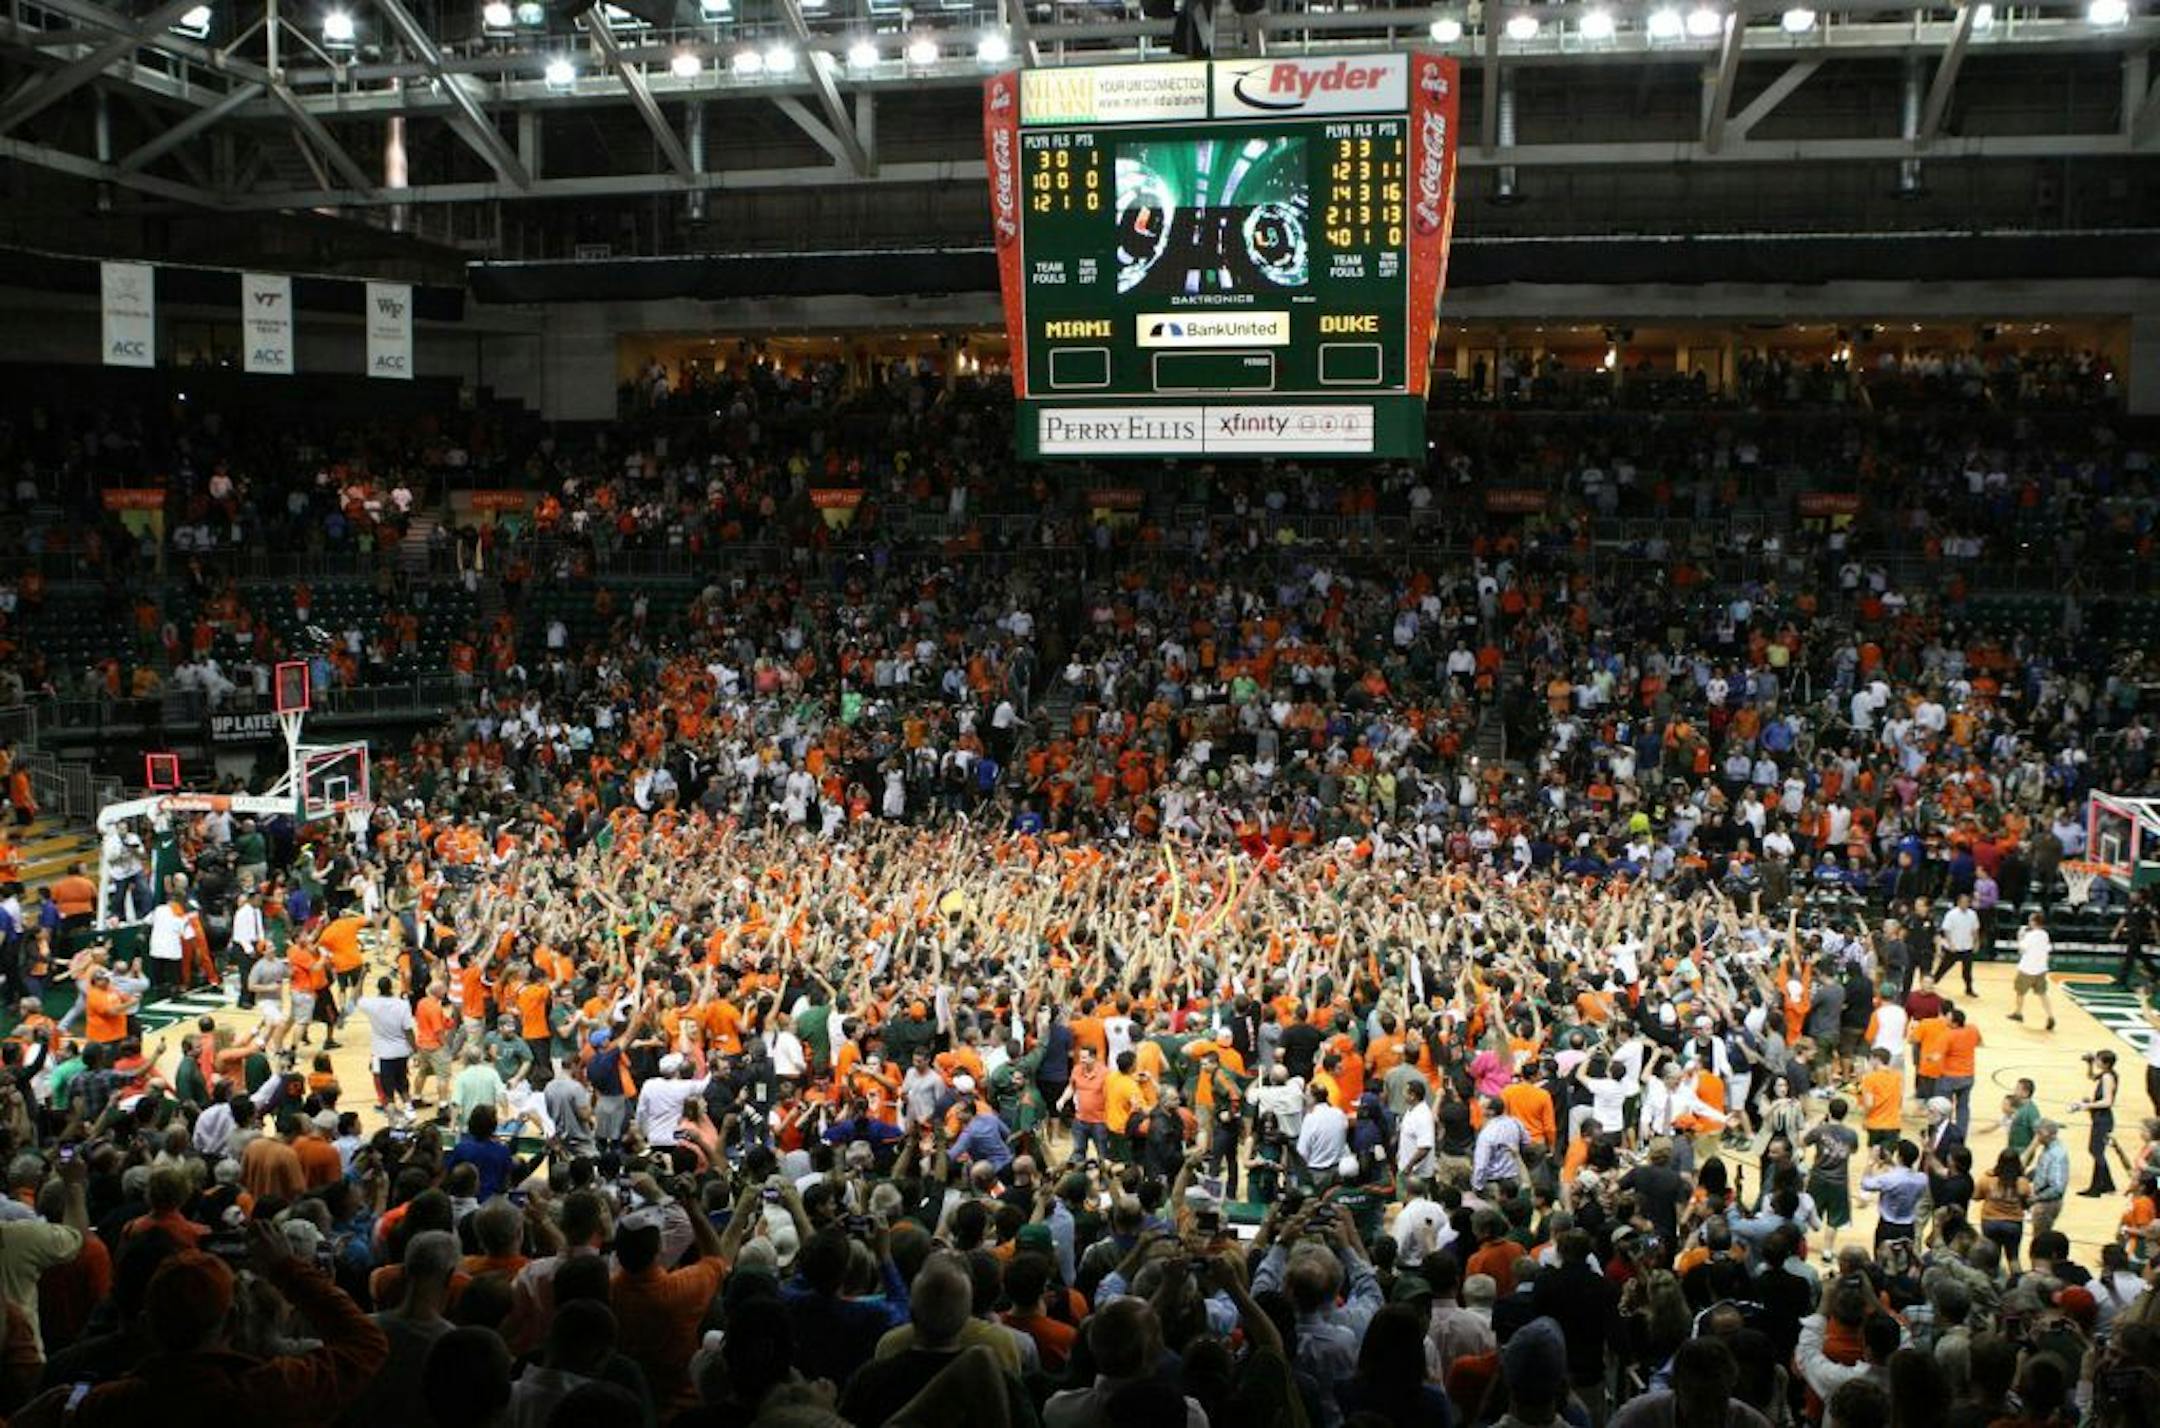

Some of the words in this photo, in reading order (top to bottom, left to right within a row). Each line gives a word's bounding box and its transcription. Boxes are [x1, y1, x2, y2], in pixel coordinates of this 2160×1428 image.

[1270, 62, 1386, 99] Ryder
[1325, 124, 1351, 138] PLYR
[1354, 123, 1373, 136] FLS
[1378, 122, 1398, 136] PTS
[1024, 135, 1050, 149] PLYR
[1052, 134, 1070, 147] FLS
[1075, 133, 1094, 147] PTS
[1341, 139, 1351, 158] 3
[1360, 139, 1370, 157] 3
[1395, 140, 1402, 155] 1
[1040, 150, 1050, 169] 3
[1056, 149, 1069, 168] 0
[1091, 150, 1098, 166] 1
[1332, 162, 1351, 180] 12
[1360, 161, 1370, 180] 3
[1383, 162, 1402, 178] 11
[1033, 172, 1050, 191] 10
[1057, 171, 1069, 189] 0
[1086, 170, 1098, 189] 0
[1332, 185, 1351, 201] 14
[1360, 183, 1370, 202] 3
[1383, 182, 1401, 201] 16
[1034, 193, 1052, 212] 12
[1064, 194, 1070, 210] 1
[1087, 191, 1098, 210] 0
[1327, 206, 1351, 225] 21
[1360, 205, 1370, 224] 3
[1383, 205, 1401, 224] 13
[1326, 228, 1351, 247] 40
[1364, 230, 1371, 245] 1
[1388, 226, 1401, 246] 0
[1035, 261, 1065, 273] TEAM
[1332, 254, 1362, 267] TEAM
[1032, 273, 1067, 284] FOULS
[1329, 267, 1365, 278] FOULS
[254, 292, 282, 307] VT
[1171, 294, 1255, 305] DAKTRONICS
[1045, 320, 1112, 338] MIAMI
[1187, 321, 1278, 337] BankUnited
[1320, 315, 1379, 332] DUKE
[112, 341, 145, 356] ACC
[253, 348, 285, 363] ACC
[376, 355, 405, 369] ACC
[1046, 416, 1126, 440] PERRY
[1128, 415, 1195, 440] ELLIS
[1220, 413, 1289, 437] xfinity
[211, 715, 234, 732] UP
